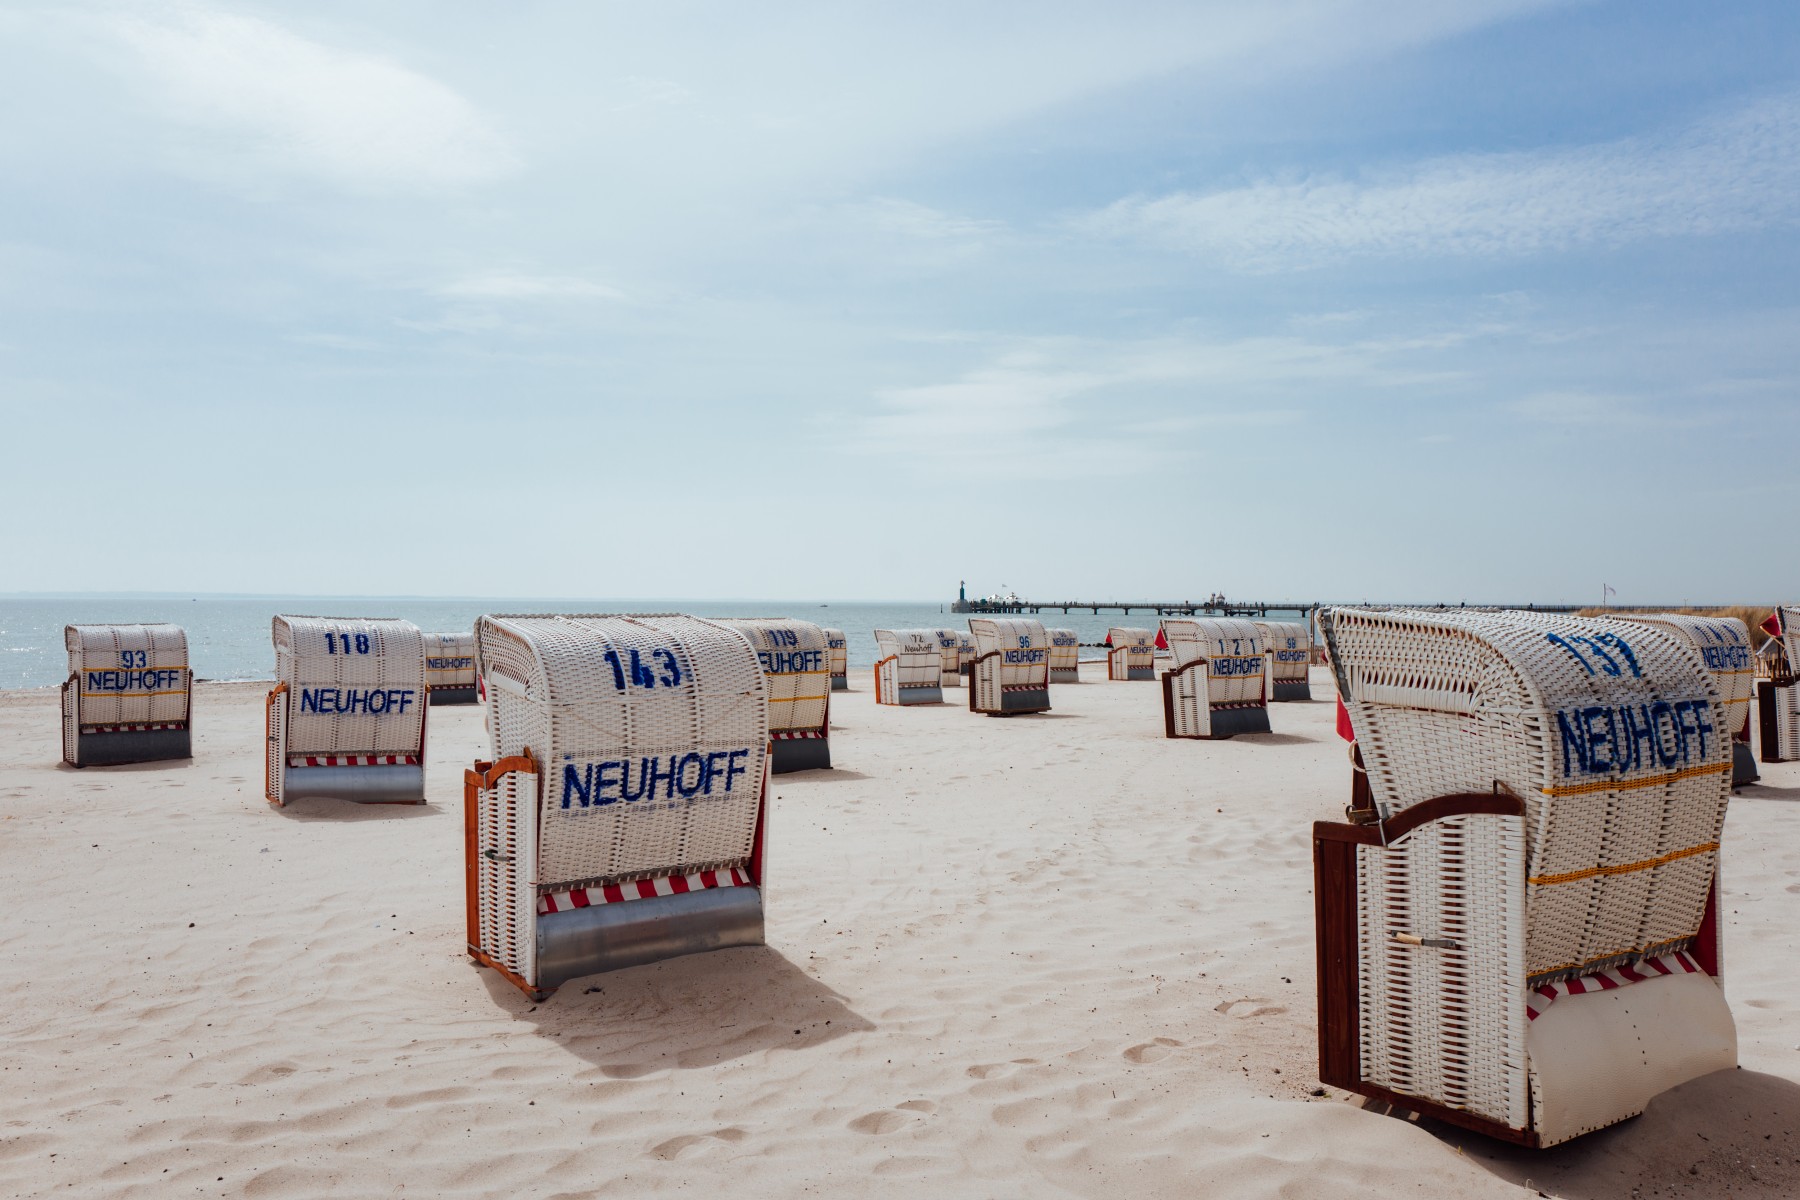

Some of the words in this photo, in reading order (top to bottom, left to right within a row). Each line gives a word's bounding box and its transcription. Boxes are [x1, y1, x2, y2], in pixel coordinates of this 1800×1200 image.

[324, 632, 369, 655] 118
[768, 629, 798, 647] 119
[827, 639, 845, 648] HOFF
[940, 639, 955, 648] HOFF
[1018, 636, 1030, 648] 96
[1052, 638, 1077, 646] NEUHOFF
[904, 643, 933, 654] Neuhoff
[1004, 649, 1045, 664] NEUHOFF
[1129, 646, 1153, 654] NEUHOFF
[1276, 650, 1306, 662] NEUHOFF
[1701, 645, 1748, 669] NEUHOFF
[121, 650, 146, 669] 93
[427, 658, 472, 670] NEUHOFF
[757, 651, 822, 673] EUHOFF
[1213, 658, 1262, 676] NEUHOFF
[603, 648, 681, 690] 143
[88, 669, 179, 691] NEUHOFF
[301, 688, 415, 715] NEUHOFF
[1556, 700, 1712, 778] NEUHOFF
[561, 748, 748, 810] NEUHOFF
